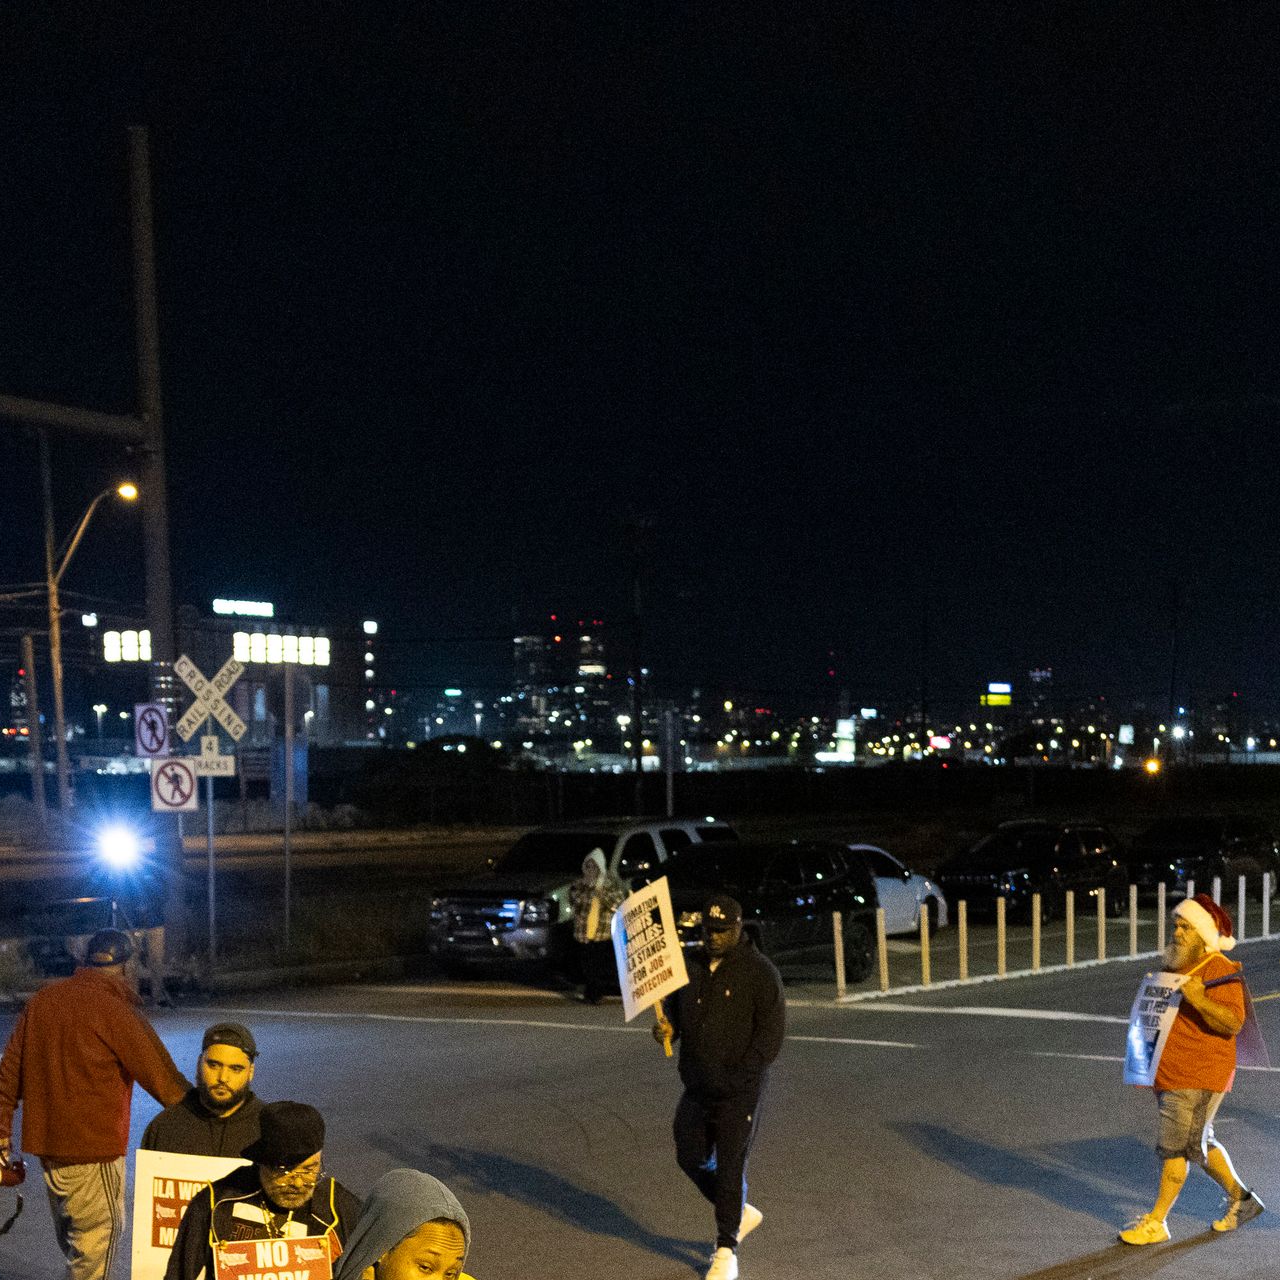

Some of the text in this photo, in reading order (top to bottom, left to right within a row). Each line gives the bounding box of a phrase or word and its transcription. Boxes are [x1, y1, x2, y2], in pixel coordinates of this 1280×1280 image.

[177, 660, 244, 737] CROSSING
[178, 707, 205, 735] RAIL
[637, 937, 667, 966] STANDS
[632, 967, 674, 1001] PROTECTION
[153, 1179, 175, 1200] ILA
[256, 1241, 288, 1268] NO
